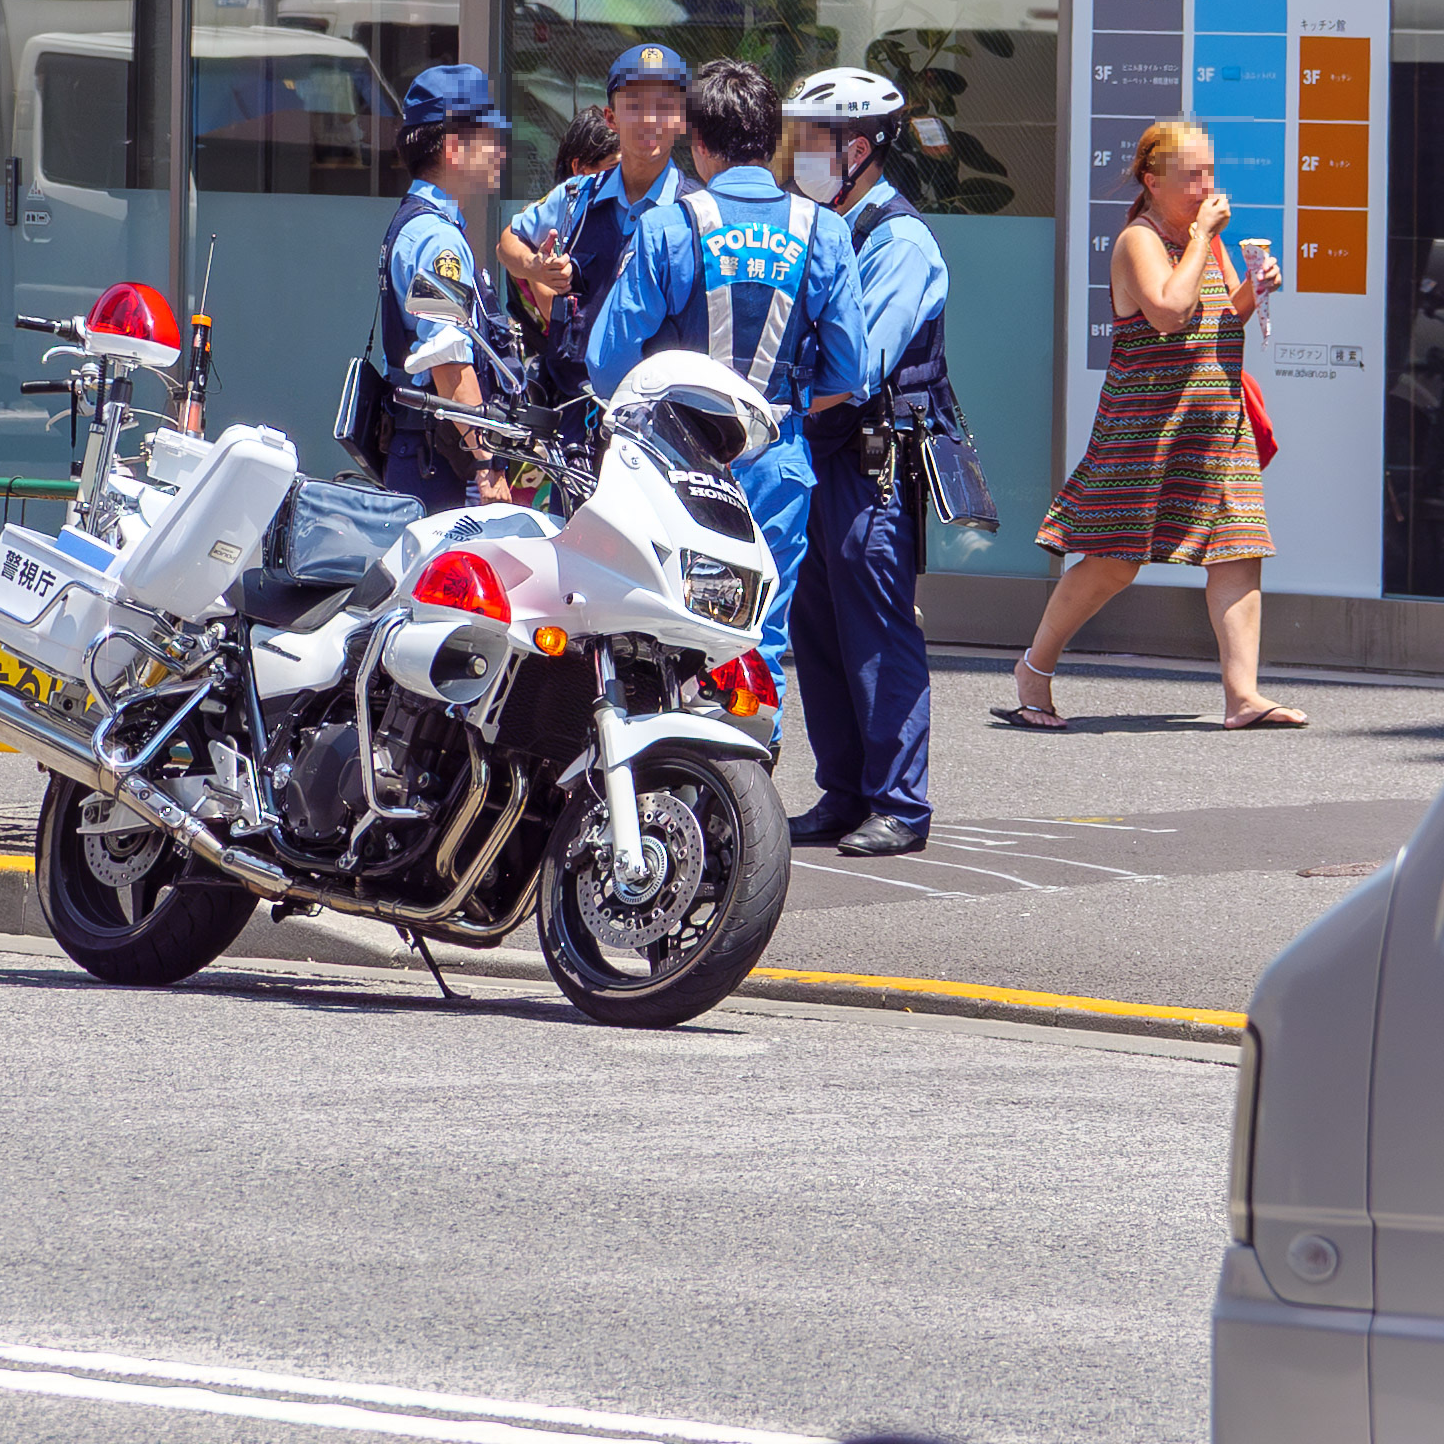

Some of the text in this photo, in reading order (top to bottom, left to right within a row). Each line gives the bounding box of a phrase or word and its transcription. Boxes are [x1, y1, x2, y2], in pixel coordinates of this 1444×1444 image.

[1300, 19, 1347, 32] キッチン館
[1094, 66, 1113, 81] 3F
[1196, 67, 1215, 82] 3F
[1303, 70, 1321, 85] 3F
[1093, 151, 1111, 166] 2F
[1301, 156, 1320, 171] 2F
[706, 228, 804, 265] POLICE
[1092, 236, 1110, 252] 1F
[1301, 243, 1318, 258] 1F
[719, 255, 791, 281] 警視庁
[1090, 323, 1113, 337] B1F
[1279, 348, 1323, 360] アドヴァン
[1, 550, 56, 597] 警視庁
